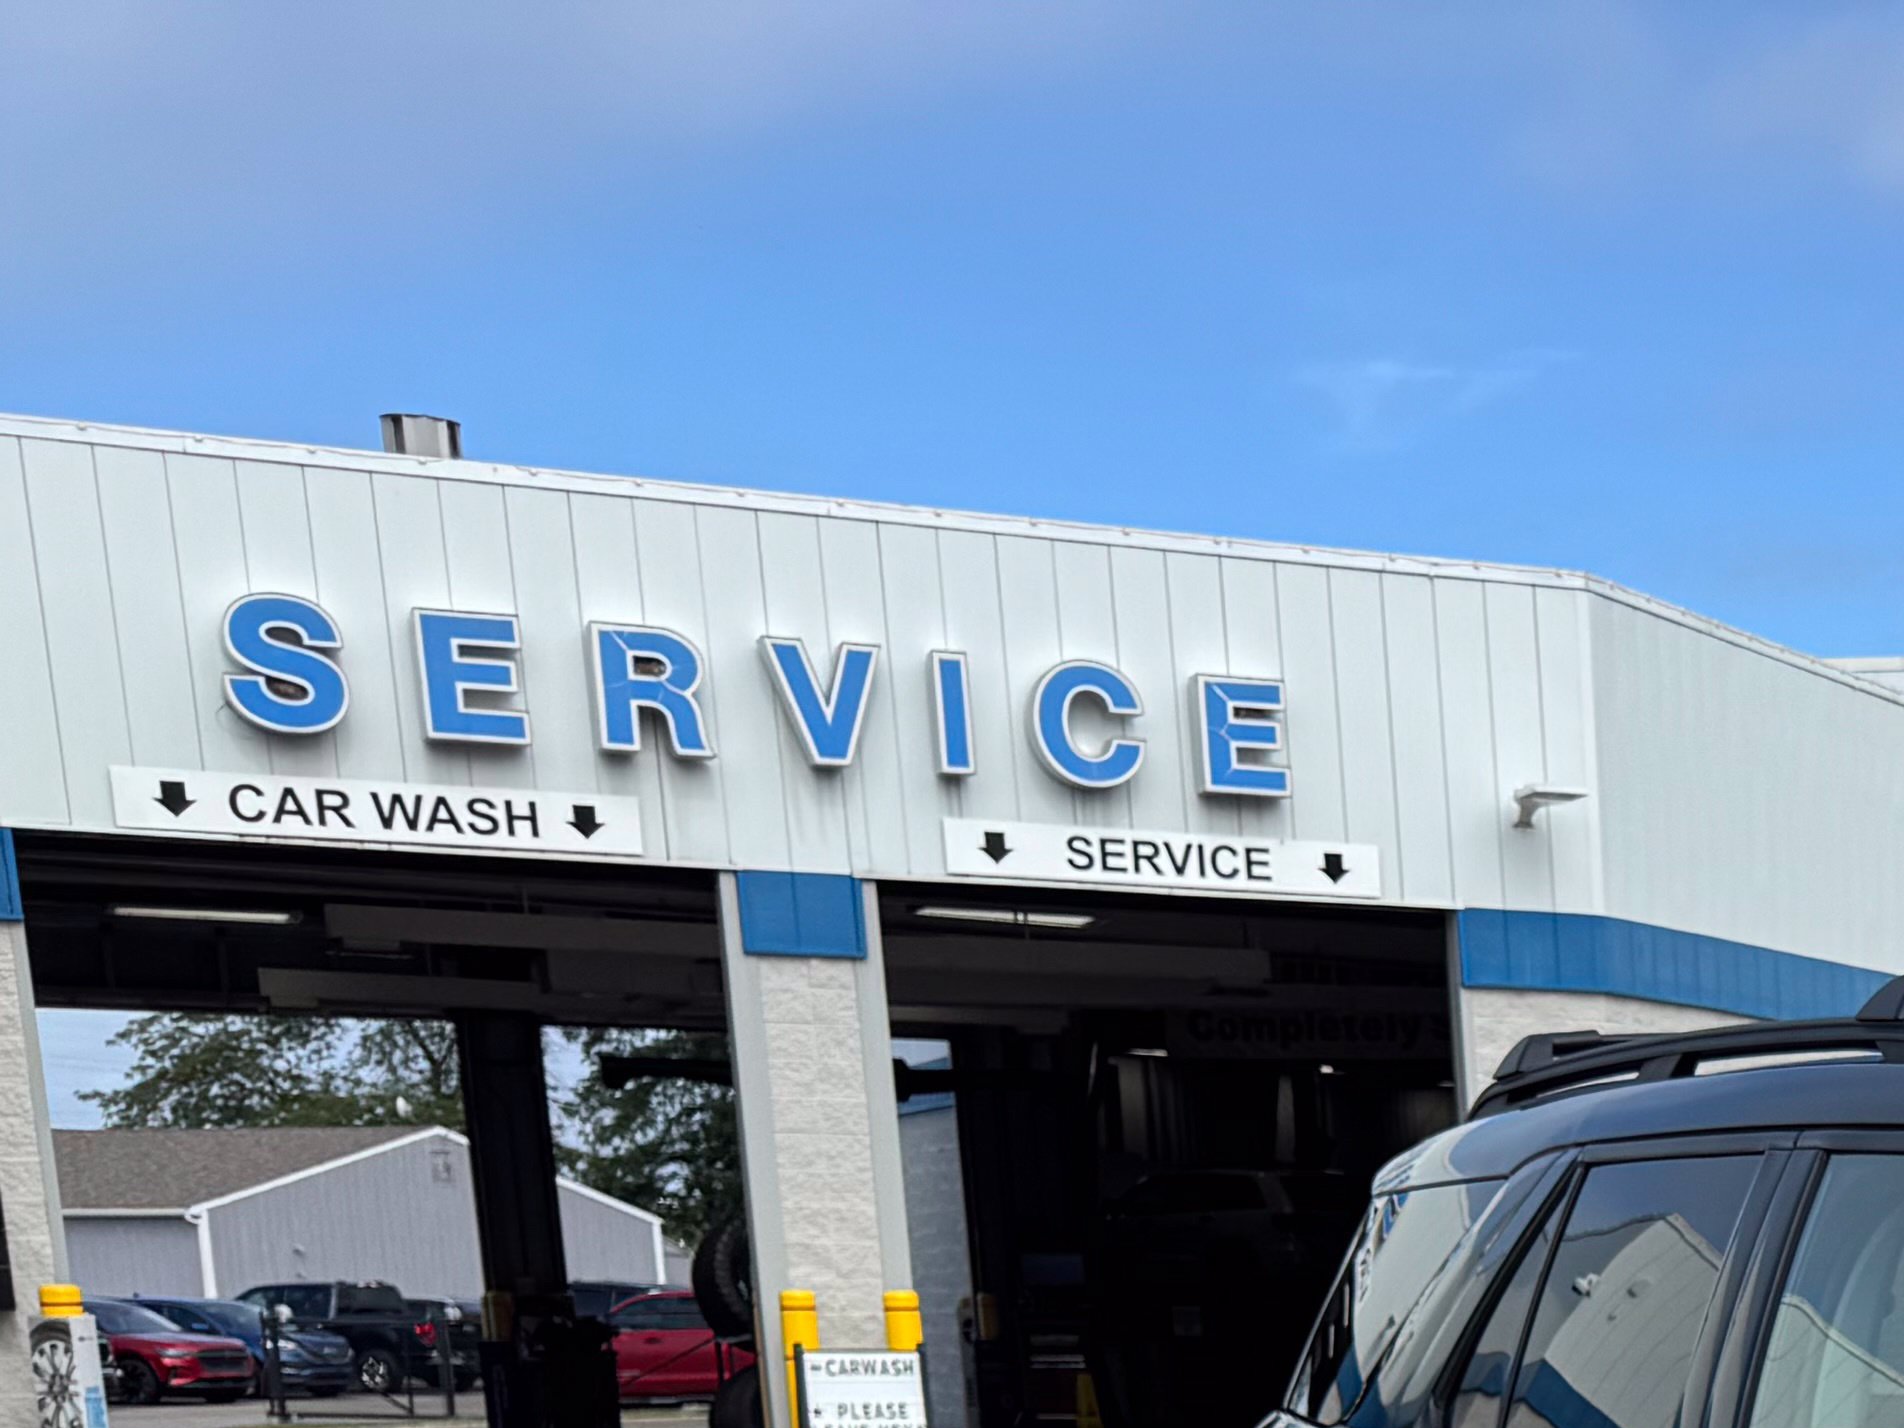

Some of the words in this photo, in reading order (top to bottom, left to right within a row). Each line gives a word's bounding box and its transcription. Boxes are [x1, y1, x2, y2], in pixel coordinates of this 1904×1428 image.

[222, 592, 1293, 799] SERVICE
[228, 783, 355, 829] CAR
[371, 792, 540, 838] WASH
[1066, 836, 1273, 882] SERVICE
[825, 1359, 915, 1377] CARWASH
[837, 1402, 908, 1420] PLEASE
